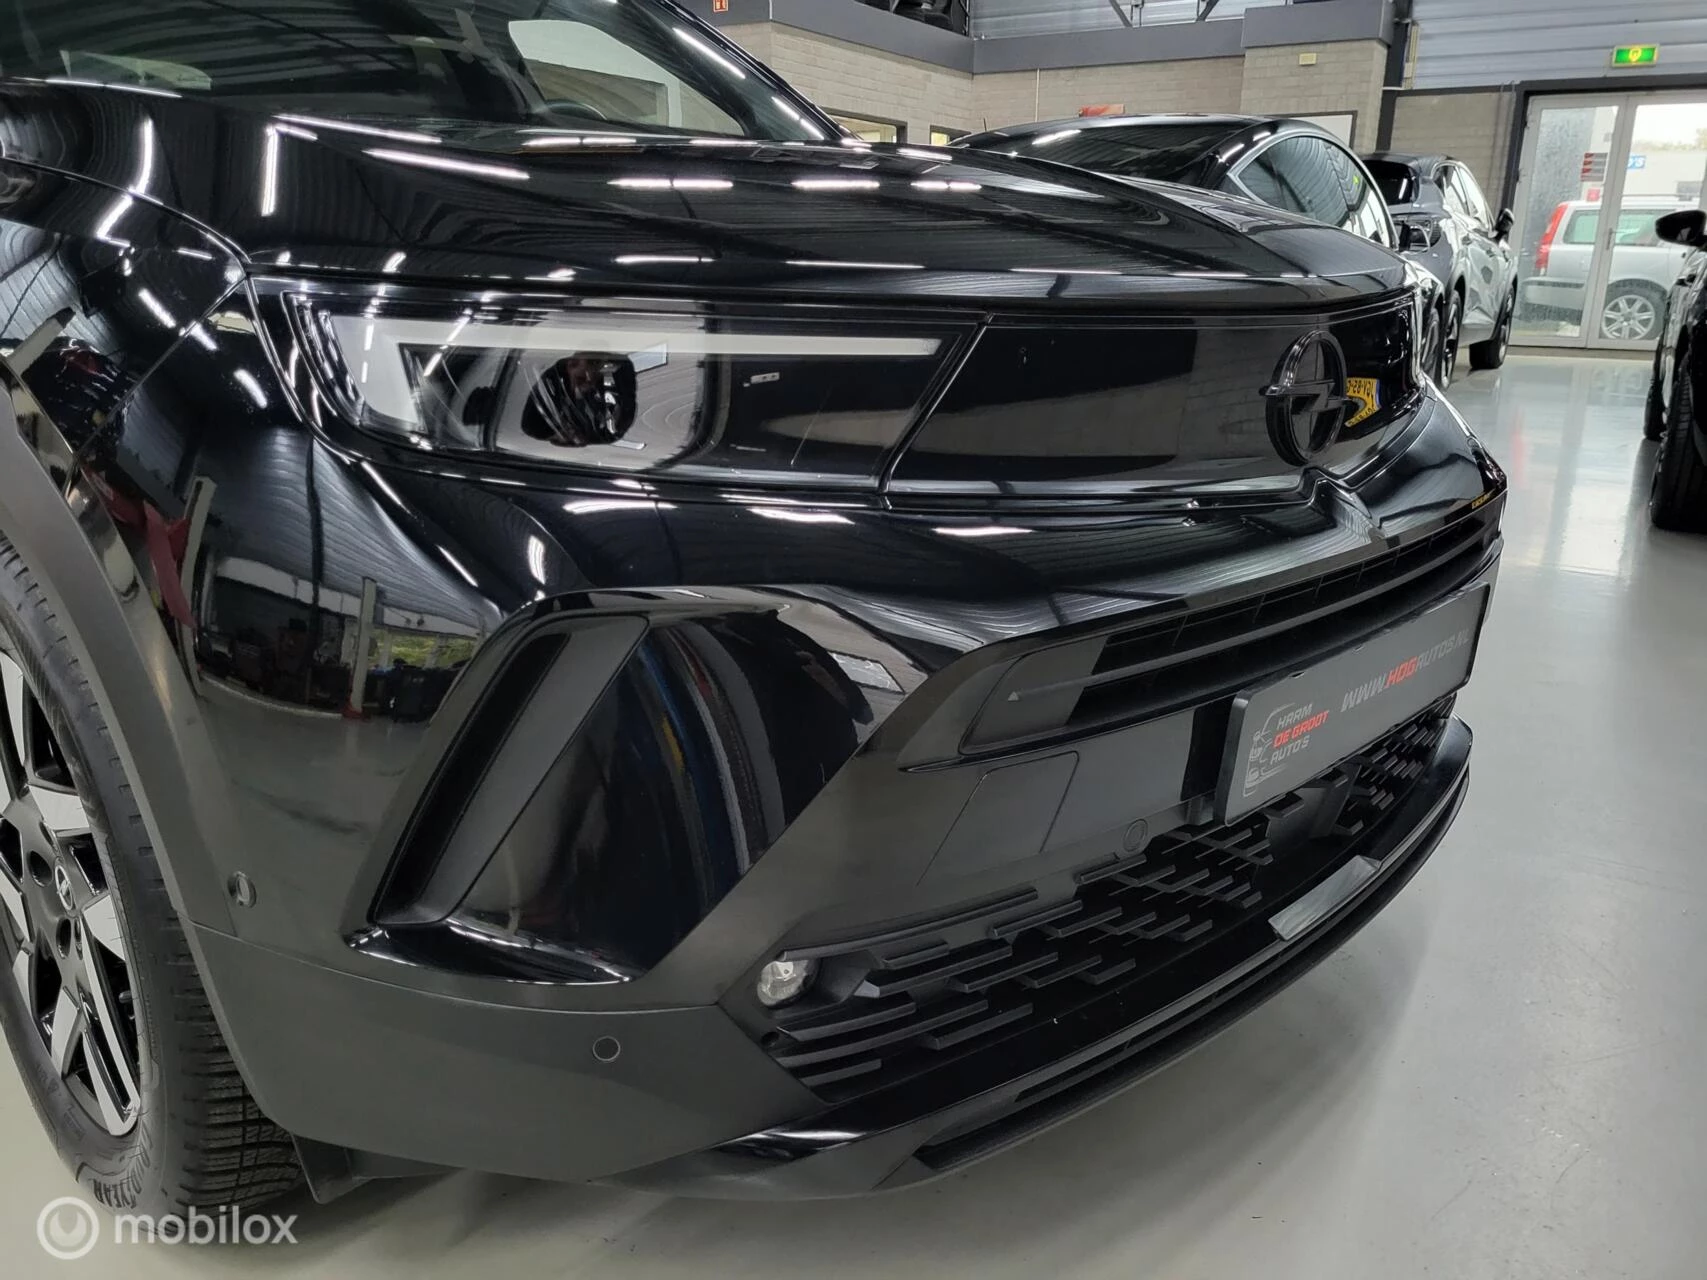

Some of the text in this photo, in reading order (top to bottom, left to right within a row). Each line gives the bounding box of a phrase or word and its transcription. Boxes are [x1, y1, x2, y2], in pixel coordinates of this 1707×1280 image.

[1273, 710, 1330, 748] DE GROOT
[1276, 703, 1313, 730] HARM
